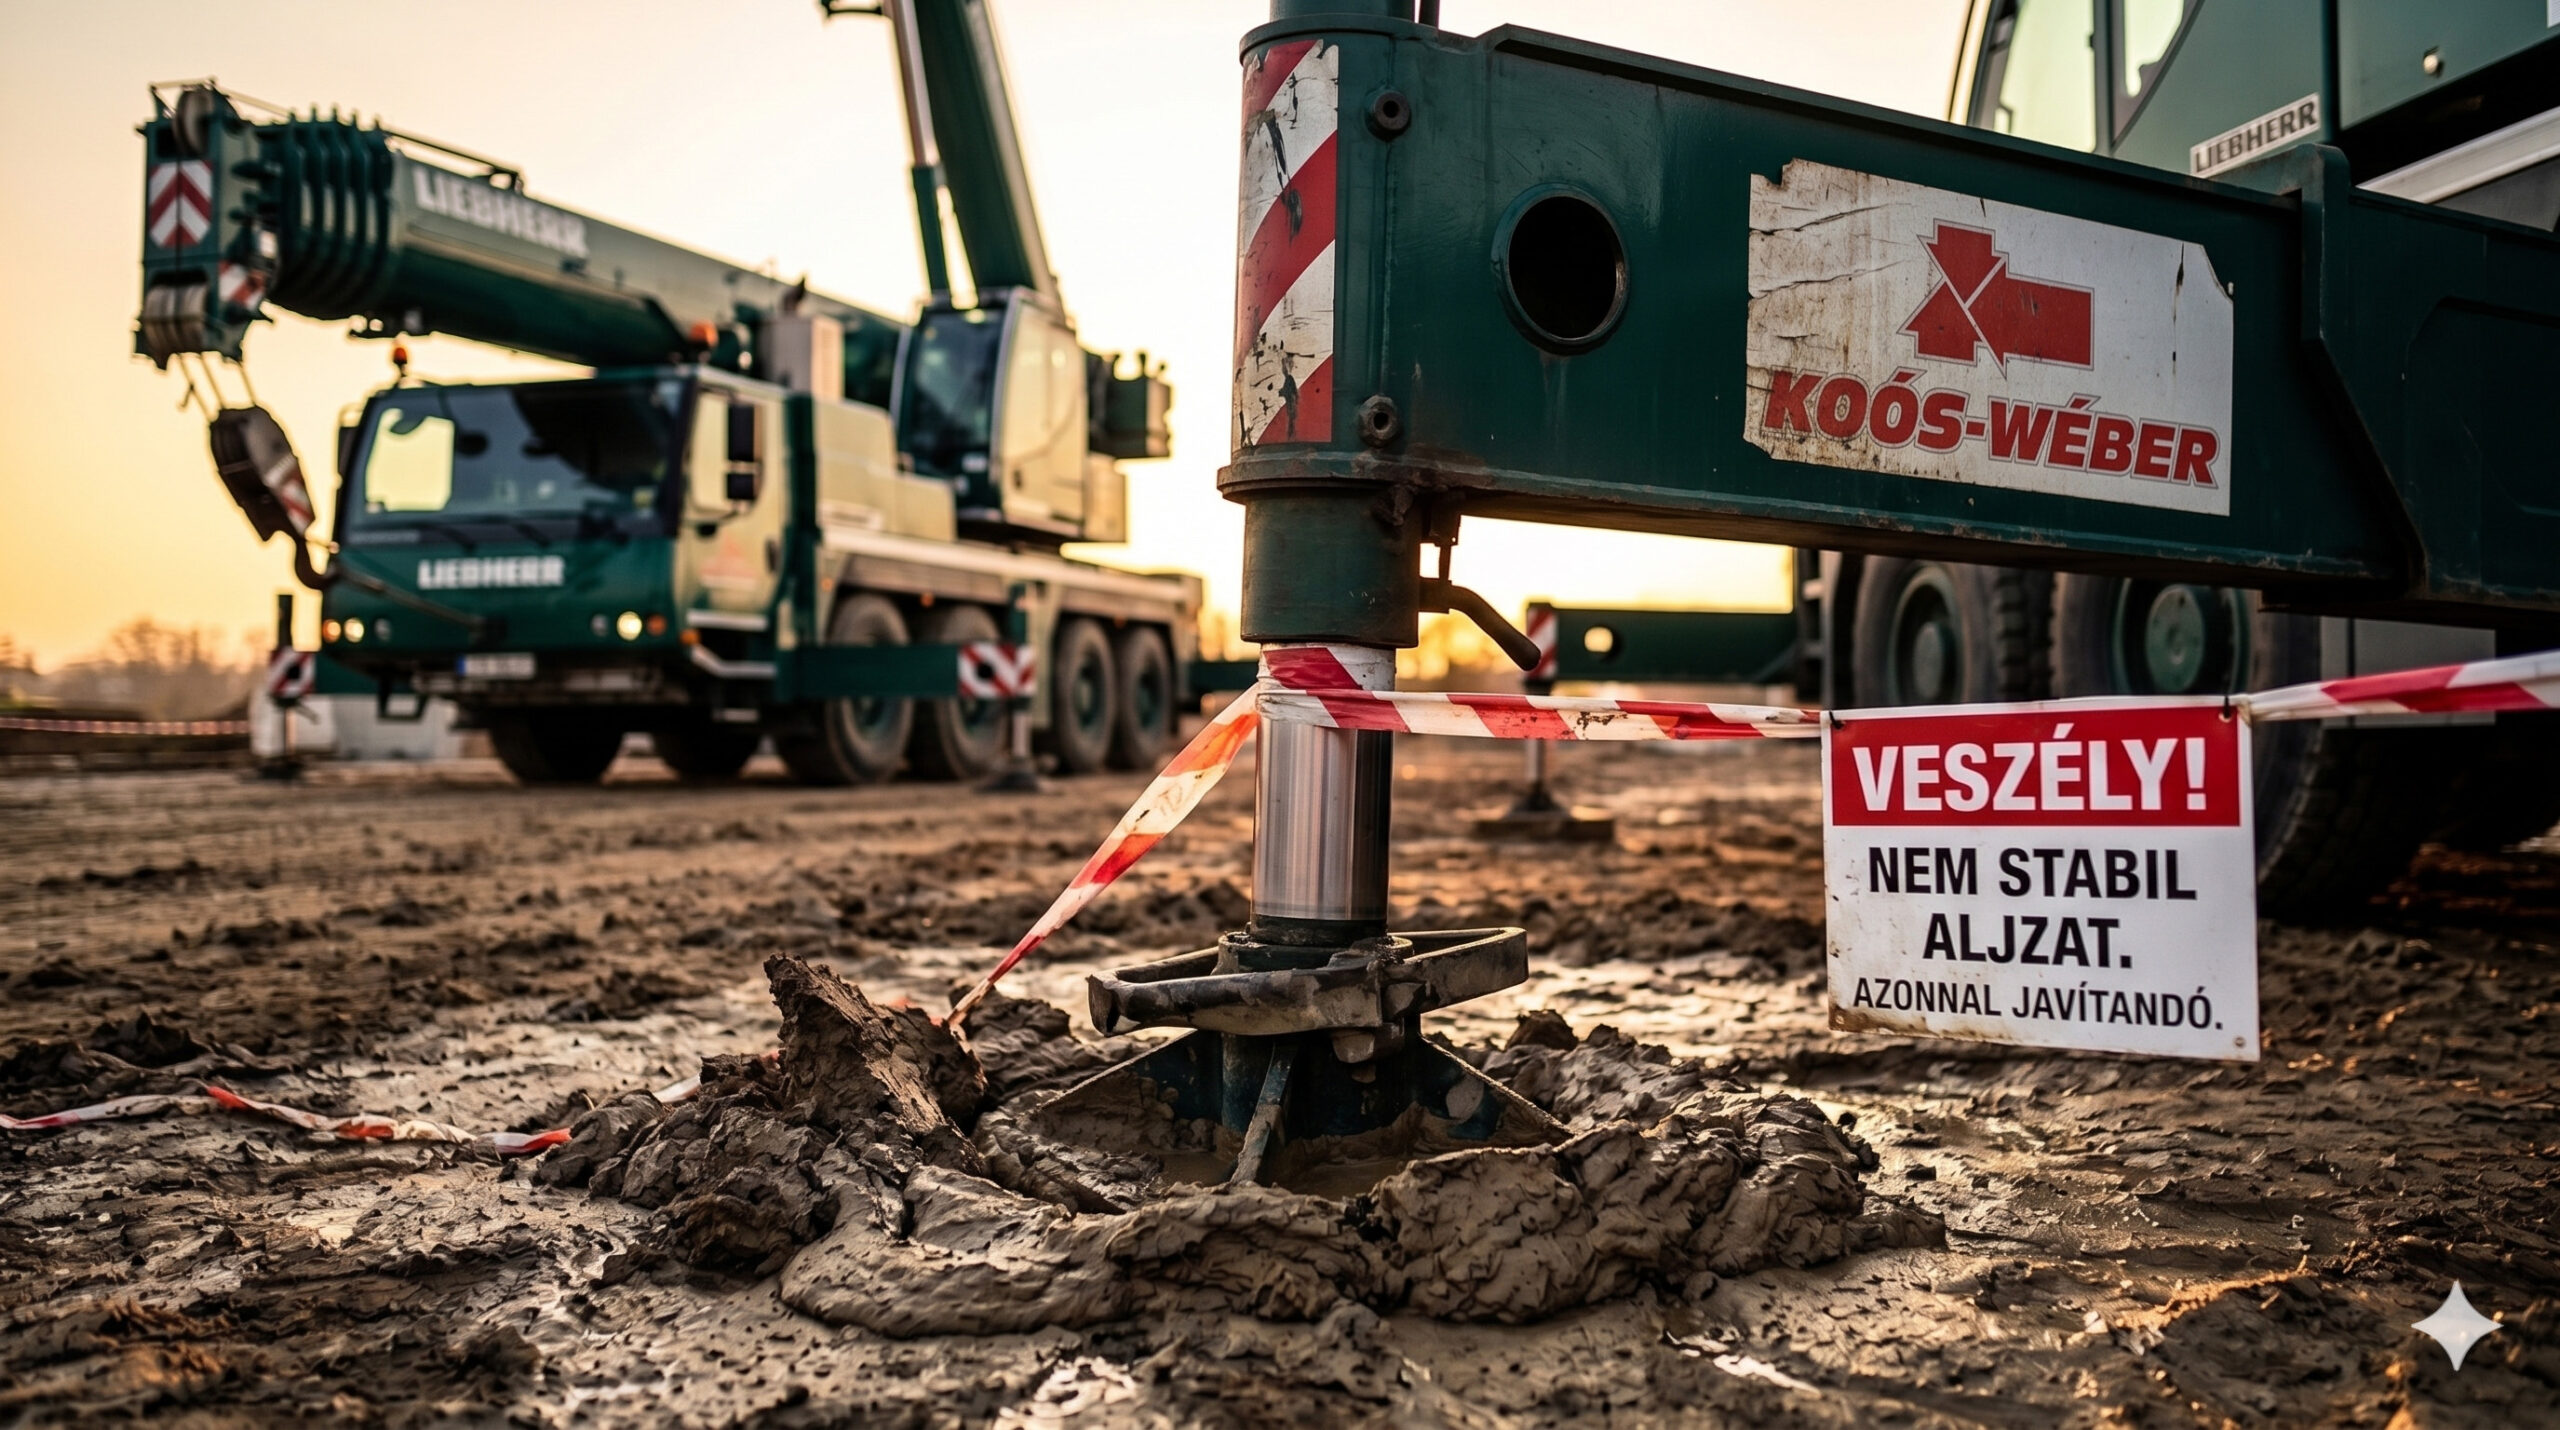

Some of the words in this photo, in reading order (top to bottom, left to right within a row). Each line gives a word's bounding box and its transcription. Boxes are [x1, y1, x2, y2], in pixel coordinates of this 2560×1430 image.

[2195, 101, 2317, 173] LIEBHERR
[412, 164, 589, 258] LIEBHERR
[1761, 368, 2219, 488] KOÓS-WÉBER
[417, 555, 565, 590] LIEBHERR
[1852, 723, 2207, 812] VESZÉLY!
[1869, 847, 1978, 895] NEM
[1999, 847, 2198, 900] STABIL
[1922, 913, 2132, 969] ALJZAT.
[1853, 977, 2001, 1016] AZONNAL
[2012, 981, 2223, 1030] JAVÍTANDÓ.
